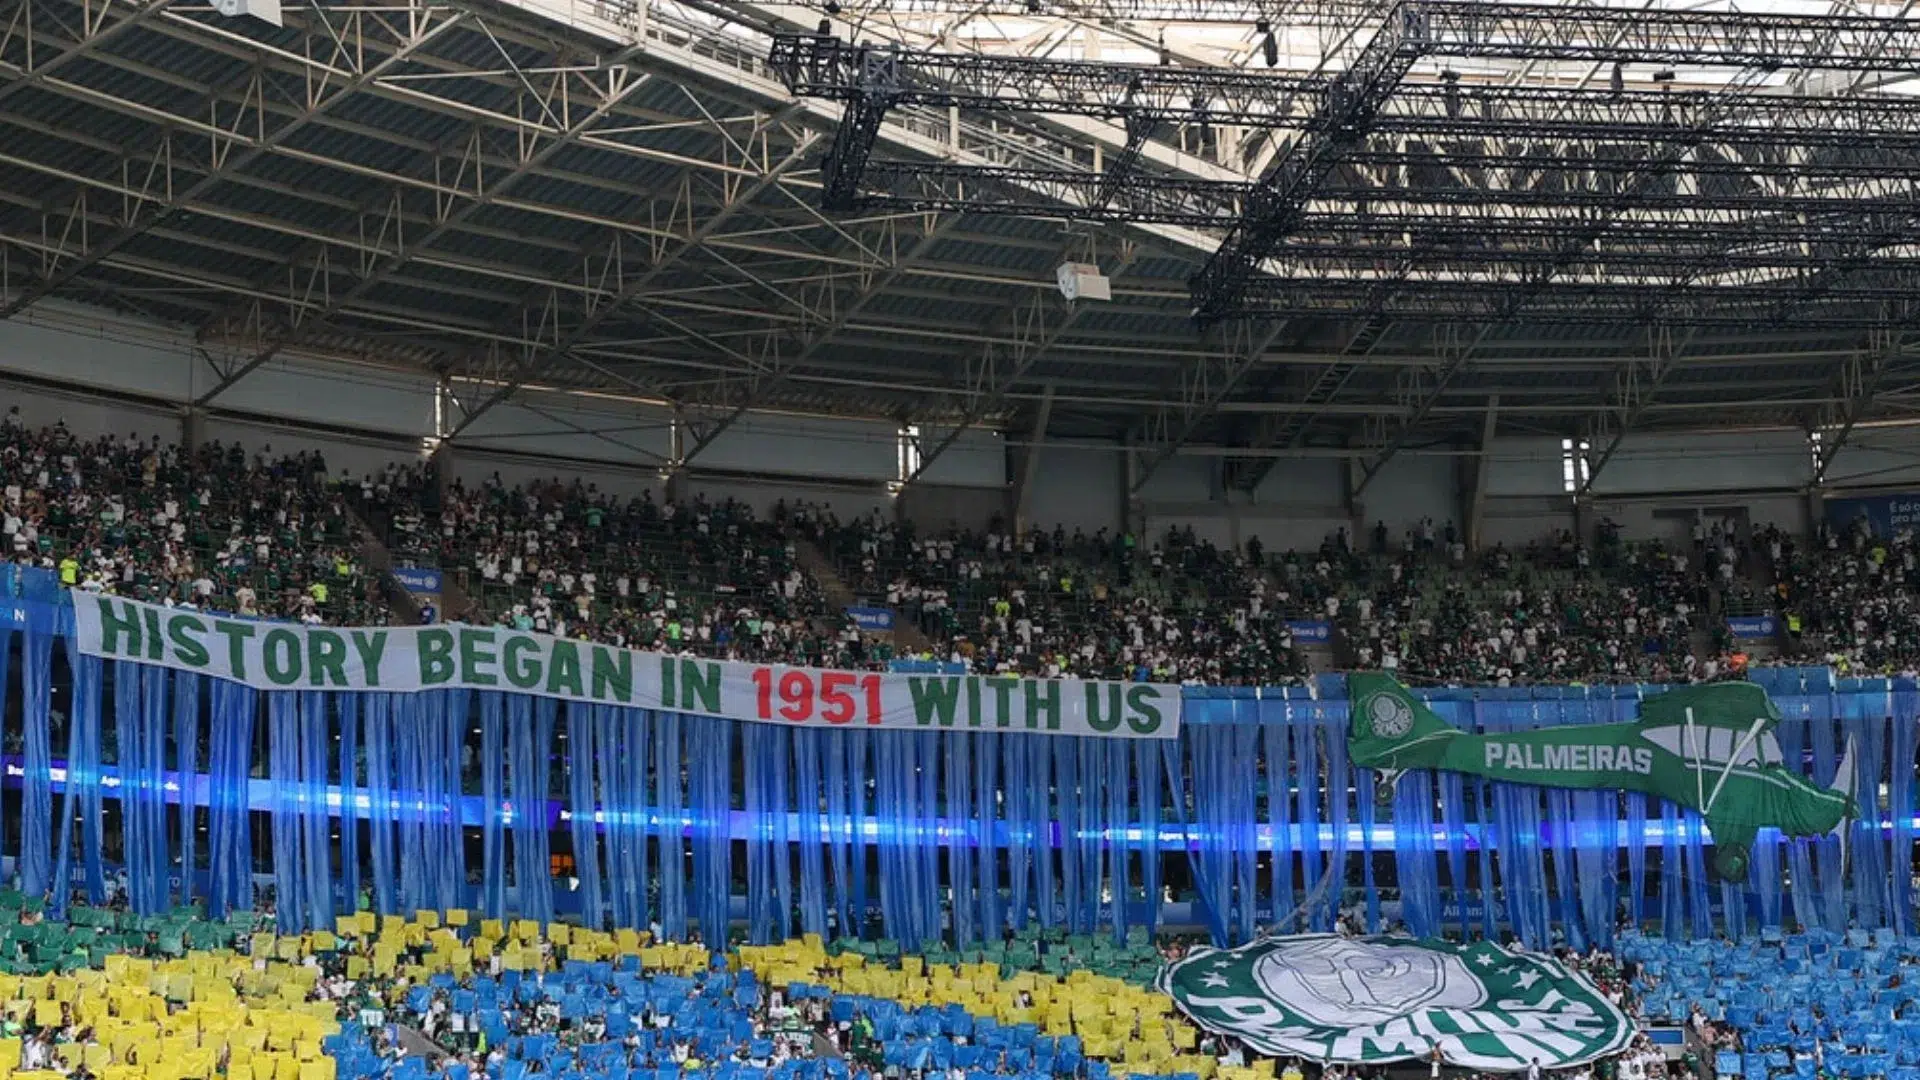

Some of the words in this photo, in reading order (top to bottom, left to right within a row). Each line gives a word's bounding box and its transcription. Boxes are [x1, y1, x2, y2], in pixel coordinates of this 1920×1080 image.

[97, 597, 388, 687] HISTORY
[416, 628, 633, 703] BEGAN
[661, 656, 721, 714] IN
[751, 667, 883, 726] 1951
[908, 675, 1061, 730] WITH
[1085, 682, 1163, 735] US
[1484, 741, 1653, 775] PALMEIRAS
